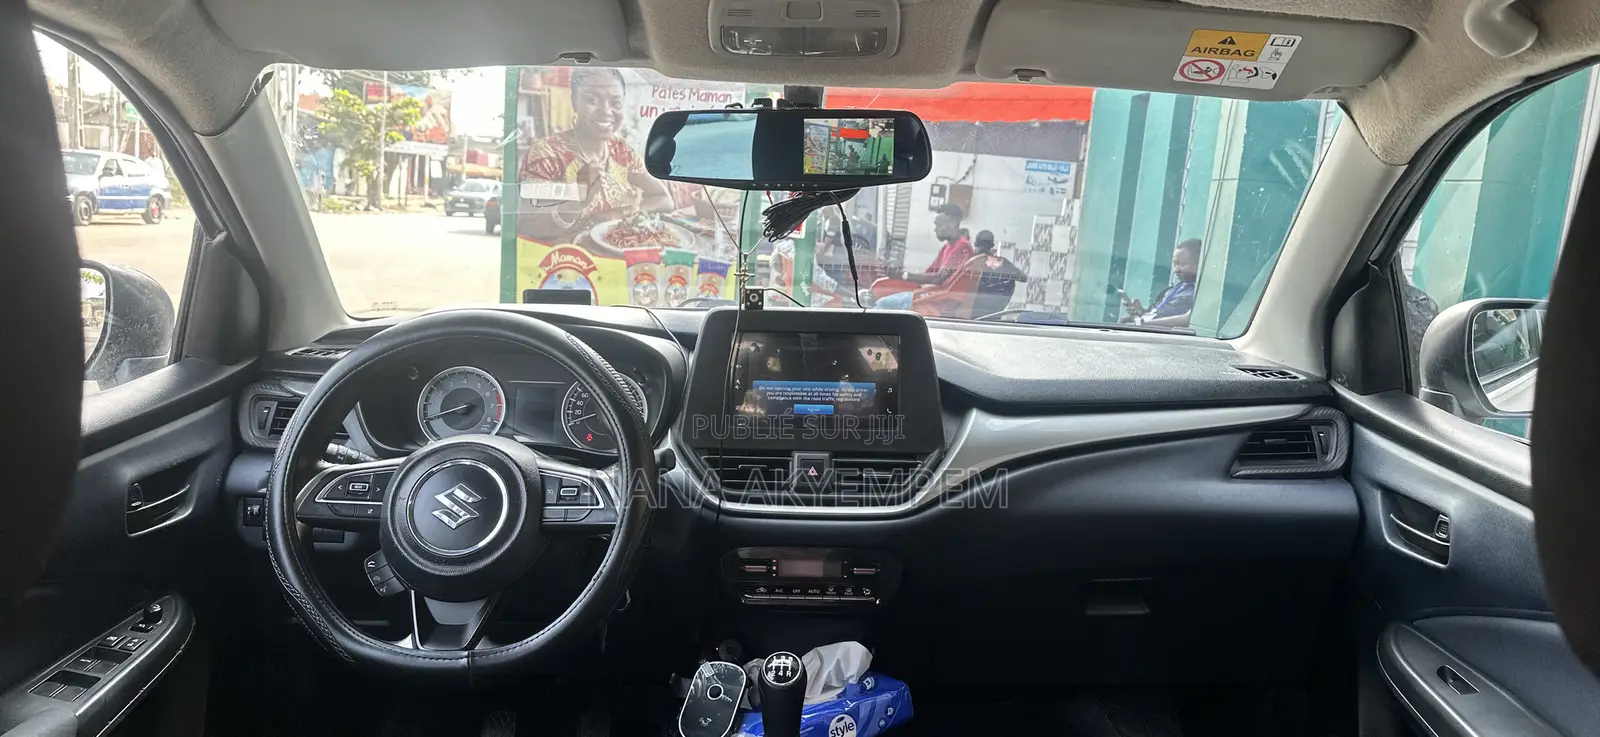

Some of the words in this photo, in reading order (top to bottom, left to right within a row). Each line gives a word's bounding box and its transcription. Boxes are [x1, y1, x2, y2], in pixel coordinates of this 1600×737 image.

[1191, 46, 1256, 57] AIRBAG
[652, 84, 685, 99] Pâtes
[688, 88, 732, 102] Maman
[640, 104, 658, 118] un
[830, 721, 855, 737] style
